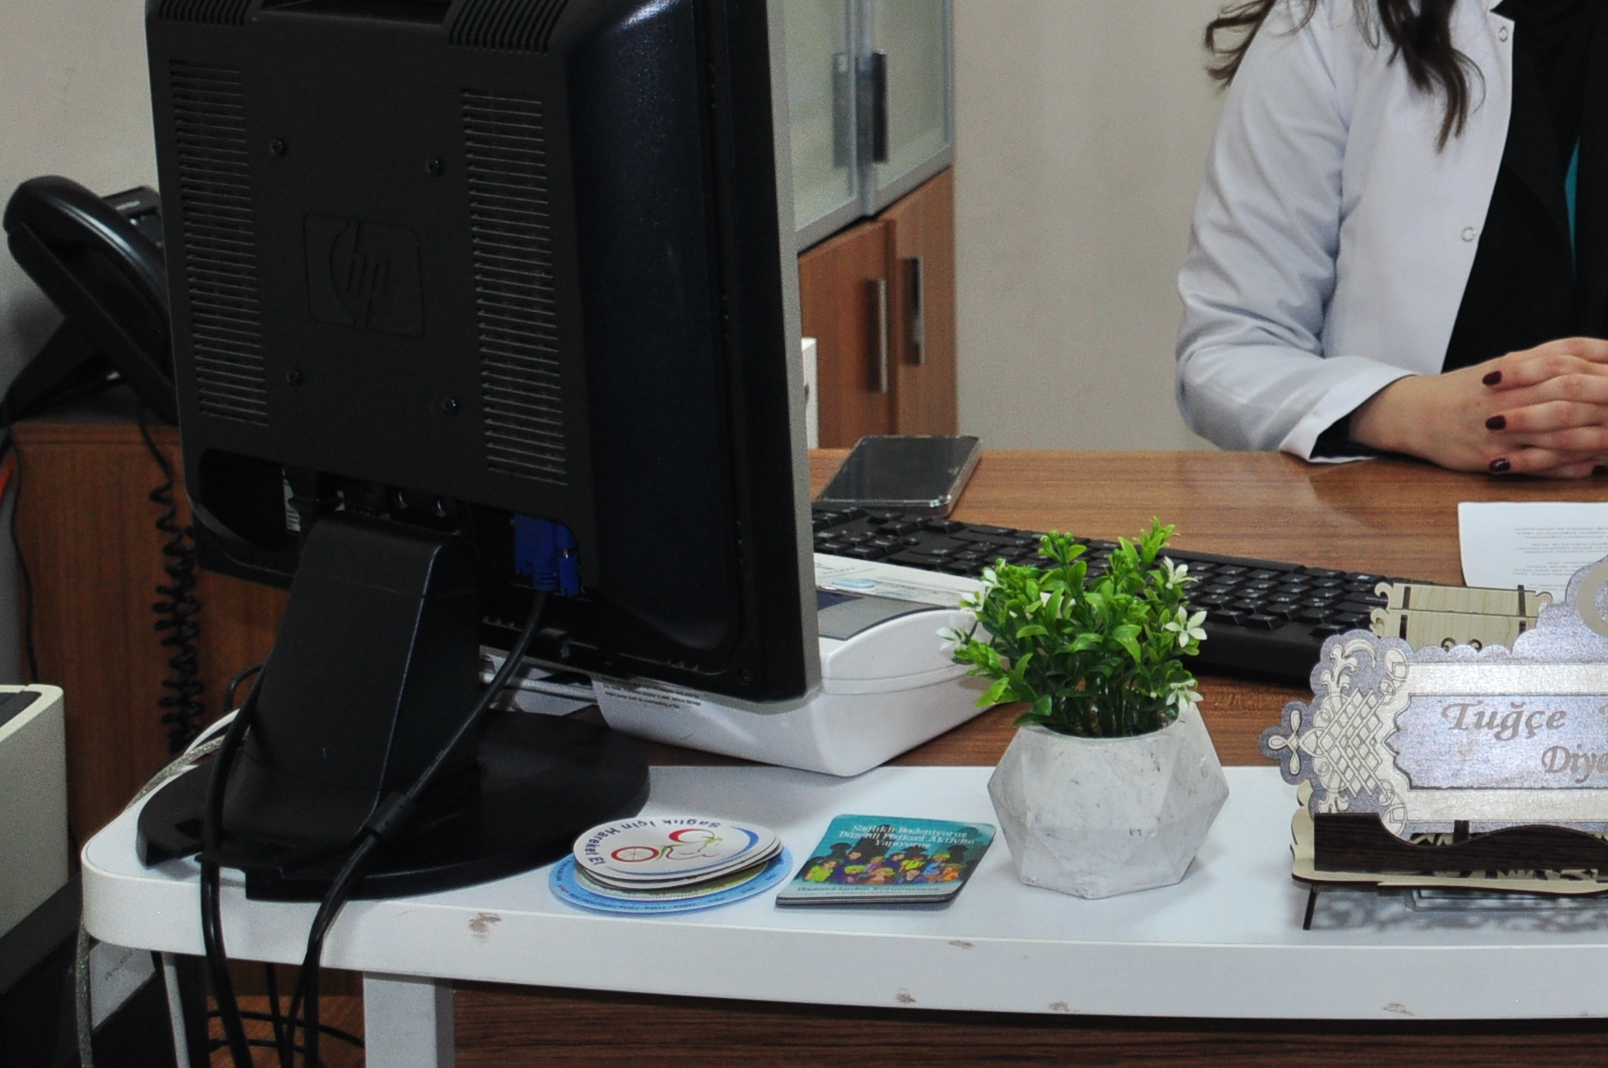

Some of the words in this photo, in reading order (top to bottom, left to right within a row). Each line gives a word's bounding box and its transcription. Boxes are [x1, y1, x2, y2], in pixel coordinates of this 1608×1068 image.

[1441, 701, 1567, 741] Tuğçe
[663, 818, 722, 828] Sağlık
[838, 830, 880, 840] Düzenli
[928, 833, 976, 846] Aktivite
